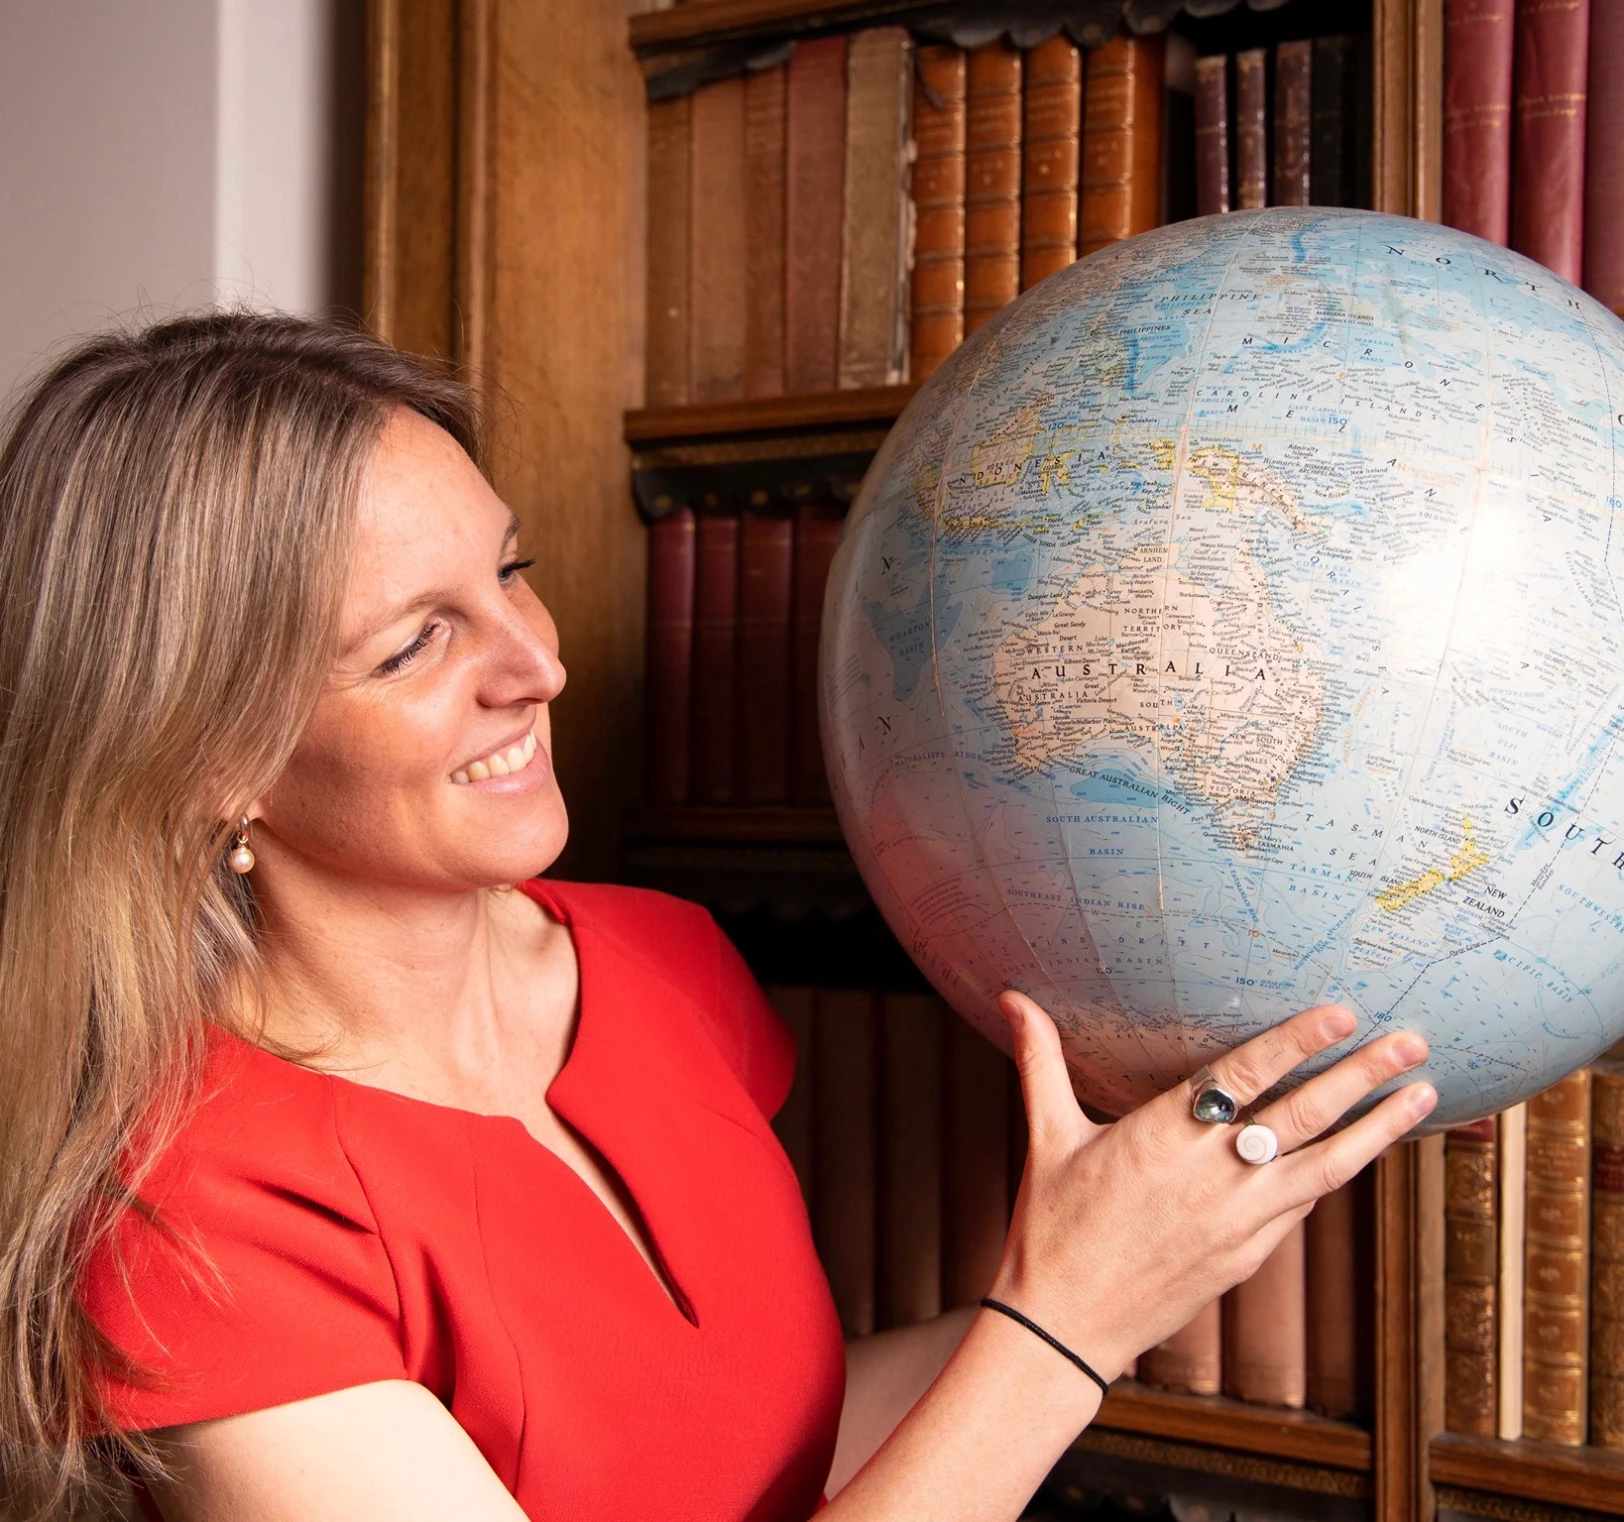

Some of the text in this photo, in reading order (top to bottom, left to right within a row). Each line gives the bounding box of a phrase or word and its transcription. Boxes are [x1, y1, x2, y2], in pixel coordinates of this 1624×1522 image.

[1382, 244, 1580, 309] NORTH
[1161, 293, 1262, 303] PHILIPPINE
[1154, 301, 1208, 310] PHILIPPINE
[1158, 313, 1186, 321] BASIN
[1316, 310, 1374, 320] MARIANA ISLANDS
[1119, 324, 1171, 334] PHILIPPINES
[1355, 337, 1394, 347] MARIANA
[1196, 389, 1313, 402] CAROLINE
[1312, 406, 1354, 415] CAROLINE
[1340, 398, 1437, 420] ISLANDS
[1300, 416, 1326, 424] BASIN
[1567, 415, 1598, 432] MARSHALL
[1573, 433, 1598, 446] ISLANDS
[1288, 444, 1318, 452] Admiralty
[986, 459, 1014, 471] BORNEO
[1263, 458, 1301, 467] Bismarck
[1304, 463, 1335, 471] BISMARCK
[1299, 469, 1341, 478] ARCHIPELAGO
[1328, 489, 1350, 498] Britain
[1380, 490, 1415, 502] Bougainville
[1574, 487, 1596, 498] GILBERT
[1418, 511, 1458, 524] SOLOMON
[1577, 508, 1598, 522] ISLANDS
[1133, 518, 1168, 526] Arafura
[1344, 518, 1376, 527] Solomon
[1022, 532, 1082, 548] LESSER SUNDA ISLANDS
[1241, 537, 1268, 545] Cape York
[1239, 550, 1267, 558] Peninsula
[1316, 550, 1353, 560] Archipelago
[1321, 545, 1352, 554] Louisiade
[1187, 562, 1229, 572] Carpentaria
[1332, 577, 1362, 588] BASIN
[1564, 551, 1595, 608] ELLICE ISLANDS
[1028, 592, 1049, 601] Dampier
[1124, 605, 1178, 614] NORTHERN
[1067, 621, 1086, 629] Sandy
[1123, 623, 1182, 632] TERRITORY
[889, 620, 930, 642] WHARTON
[1059, 634, 1077, 642] Desert
[1116, 638, 1149, 649] Macdonnell
[899, 642, 924, 658] BASIN
[1026, 644, 1083, 654] WESTERN
[1209, 646, 1279, 661] QUEENSLAND
[1532, 648, 1567, 666] FIJI ISLANDS
[1031, 660, 1266, 680] AUSTRALIA
[1018, 692, 1088, 702] AUSTRALIA
[1140, 699, 1173, 709] SOUTH
[1496, 722, 1528, 738] SOUTH
[1256, 736, 1283, 746] SOUTH
[1497, 738, 1518, 750] FIJI
[894, 750, 982, 766] NATURALISTE RIDGE
[1244, 756, 1268, 765] WALES
[1489, 751, 1518, 766] BASIN
[1293, 769, 1316, 778] Sydney
[1069, 765, 1191, 816] GREAT AUSTRALIAN BIGHT
[1210, 785, 1256, 797] VICTORIA
[1240, 795, 1277, 806] Melbourne
[1046, 815, 1158, 824] SOUTH AUSTRALIAN
[1260, 821, 1298, 832] Furneaux Group
[1305, 813, 1428, 848] TASMAN
[1414, 826, 1462, 844] NORTH ISLAND
[1089, 848, 1124, 856] BASIN
[1257, 841, 1294, 852] TASMANIA
[1329, 848, 1377, 866] SEA
[1290, 863, 1354, 882] TASMAN
[1350, 870, 1404, 886] SOUTH ISLAND
[1531, 863, 1550, 886] Monday
[1538, 869, 1554, 890] Sunday
[1289, 884, 1342, 901] BASIN
[1484, 886, 1508, 899] NEW
[1007, 888, 1145, 910] SOUTHEAST INDIAN RISE
[1557, 884, 1614, 921] SOUTHWEST
[1462, 896, 1506, 918] ZEALAND
[1456, 906, 1483, 920] CHATHAM
[1364, 924, 1430, 948] NEW ZEALAND
[1031, 937, 1210, 949] WIND DRIFT
[1352, 945, 1393, 962] PLATEAU
[1115, 956, 1164, 966] BASIN
[1494, 949, 1542, 980] PACIFIC
[1546, 981, 1574, 1004] BASIN
[1086, 1034, 1209, 1043] WILKES LAND
